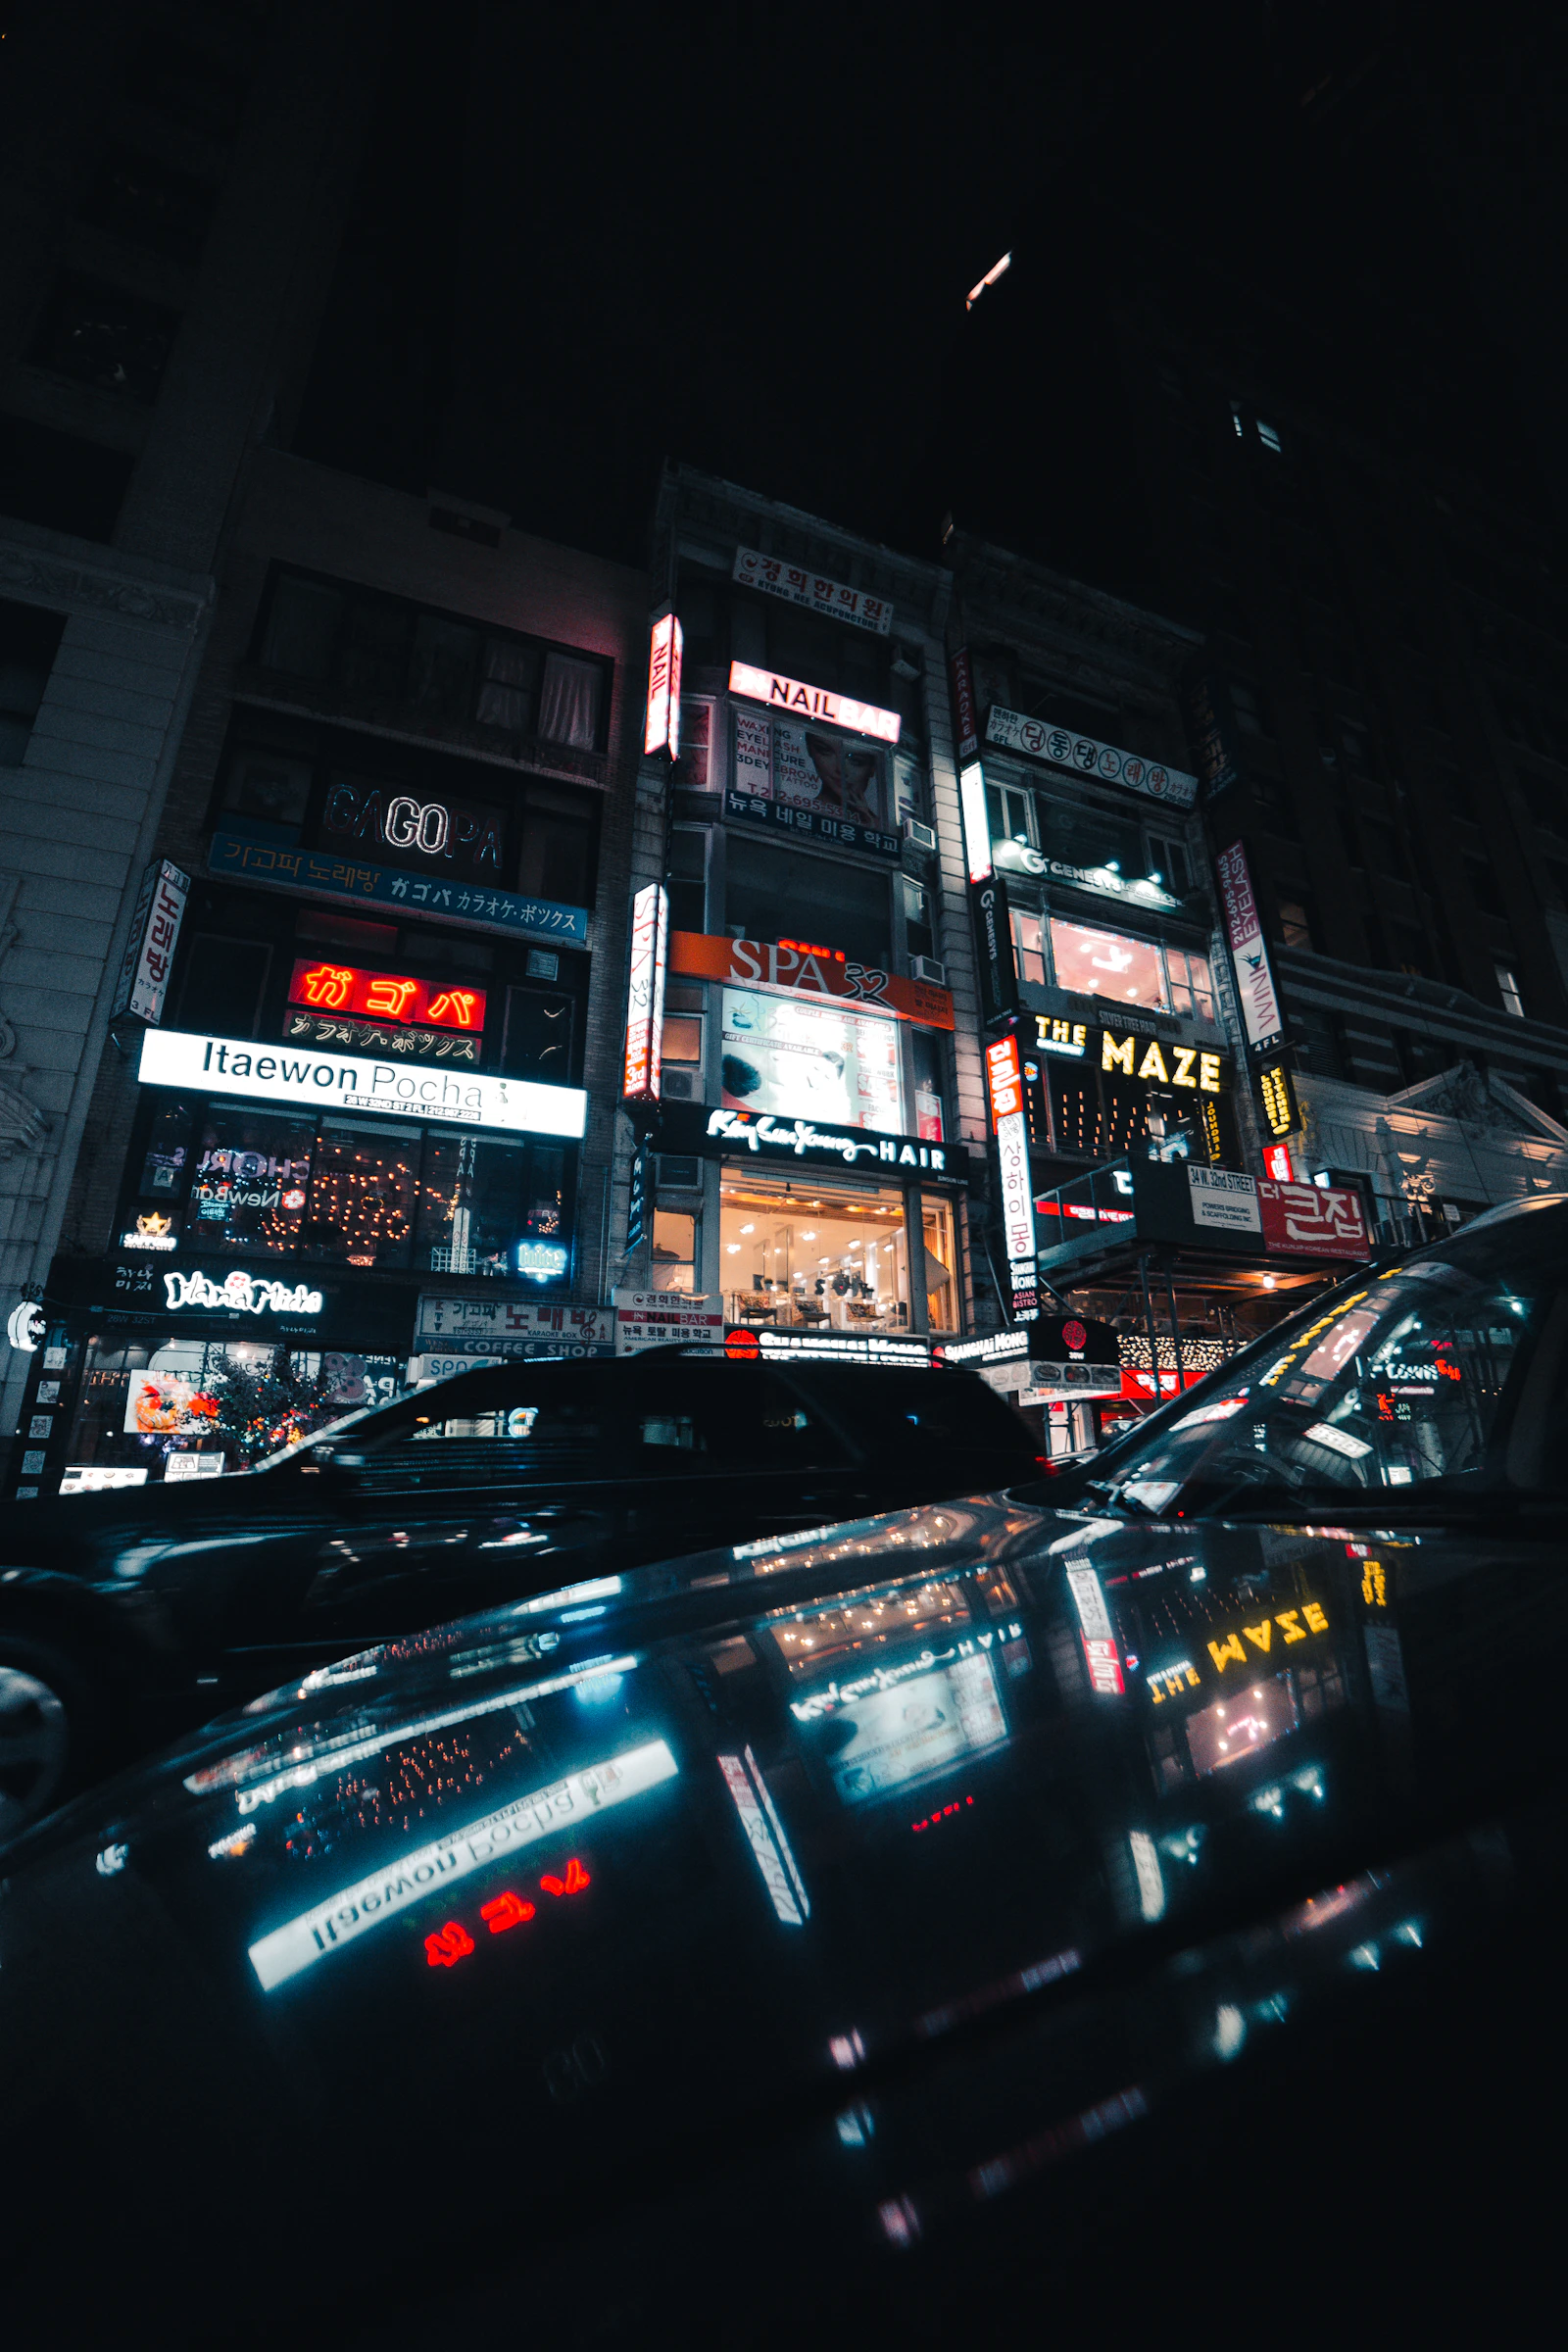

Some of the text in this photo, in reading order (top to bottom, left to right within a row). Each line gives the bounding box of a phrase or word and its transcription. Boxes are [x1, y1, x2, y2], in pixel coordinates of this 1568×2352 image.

[761, 558, 882, 620] 경희한의원
[758, 579, 789, 597] KYUNG
[794, 593, 809, 605] HEE
[813, 601, 878, 630] ACUPUNCTURE
[642, 643, 658, 700] NAIL
[770, 678, 898, 741] NAIL BAR
[955, 658, 971, 736] KARAOKE
[737, 729, 800, 755] EYELASH
[738, 718, 791, 741] WAXING
[737, 741, 806, 768] MANICURE
[781, 774, 818, 790] TATTOO
[323, 783, 503, 869] GAGOPA
[729, 793, 767, 817] 뉴욕
[776, 806, 812, 830] 네일
[821, 818, 855, 842] 미용
[863, 830, 898, 853] 학교
[307, 858, 381, 892] 노래방
[1051, 862, 1122, 893] GENESYS
[1228, 844, 1258, 939] EYELASH
[146, 882, 179, 983] 노래방
[985, 910, 998, 960] GENESYS
[729, 938, 831, 994] SPA
[841, 962, 901, 1013] 32
[1035, 1015, 1086, 1047] THE
[1099, 1009, 1157, 1035] SILVER TREE HAIR
[725, 1032, 820, 1055] GIFT CERTIFICATE AVAILABLE
[202, 1041, 483, 1108] Itaewon Pocha
[1102, 1030, 1222, 1094] MAZE
[368, 1098, 392, 1108] 32ND
[393, 1100, 405, 1110] ST
[413, 1103, 424, 1113] FL
[1260, 1074, 1278, 1119] LOUNGE
[1270, 1066, 1292, 1124] KITCHEN
[878, 1140, 946, 1171] HAIR
[157, 1170, 169, 1181] A
[1190, 1168, 1253, 1192] 34 W. 32nd STREET
[1003, 1142, 1031, 1253] 상하이몽
[1202, 1201, 1250, 1215] POWERS BRIDGING
[1206, 1211, 1242, 1222] SCAFFOLDING
[123, 1233, 177, 1249] SAPPORO
[1330, 1247, 1368, 1257] RESTAURANT
[1010, 1275, 1037, 1292] MONG
[1013, 1291, 1036, 1301] ASIAN
[1012, 1298, 1038, 1309] BISTRO
[647, 1311, 708, 1325] NAIL BAR
[622, 1325, 642, 1336] 뉴욕
[671, 1328, 691, 1338] 미용
[692, 1329, 711, 1339] 학교
[995, 1330, 1027, 1350] MONG
[464, 1341, 535, 1354] COFFEE
[547, 1344, 599, 1357] SHOP
[430, 1359, 468, 1373] spa
